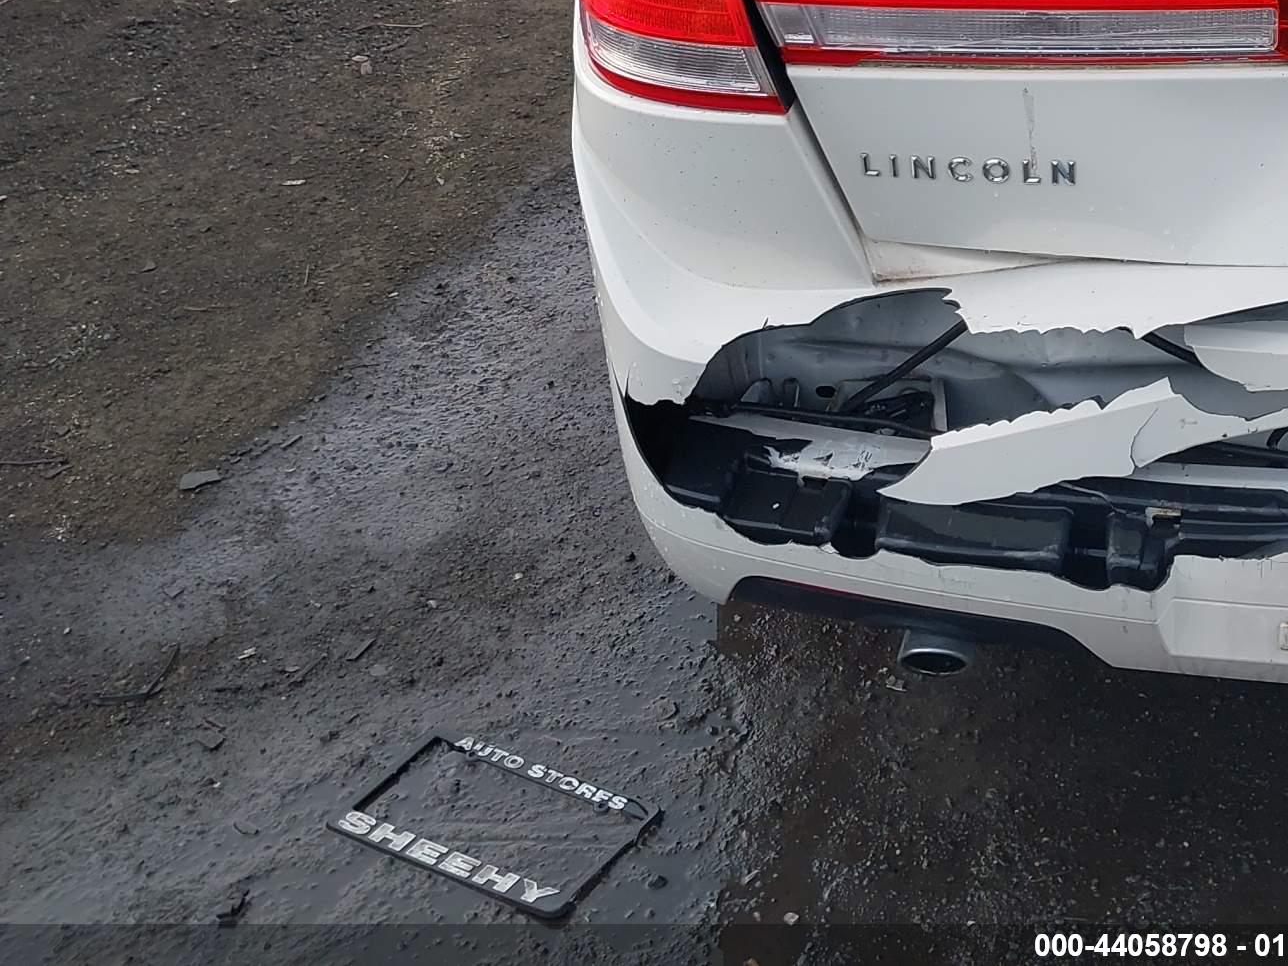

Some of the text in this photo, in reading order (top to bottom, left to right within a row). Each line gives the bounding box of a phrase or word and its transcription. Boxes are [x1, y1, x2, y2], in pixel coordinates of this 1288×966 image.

[859, 152, 1078, 186] LINCOLN
[453, 736, 628, 811] AUTO STORES
[337, 810, 561, 904] SHEEHY
